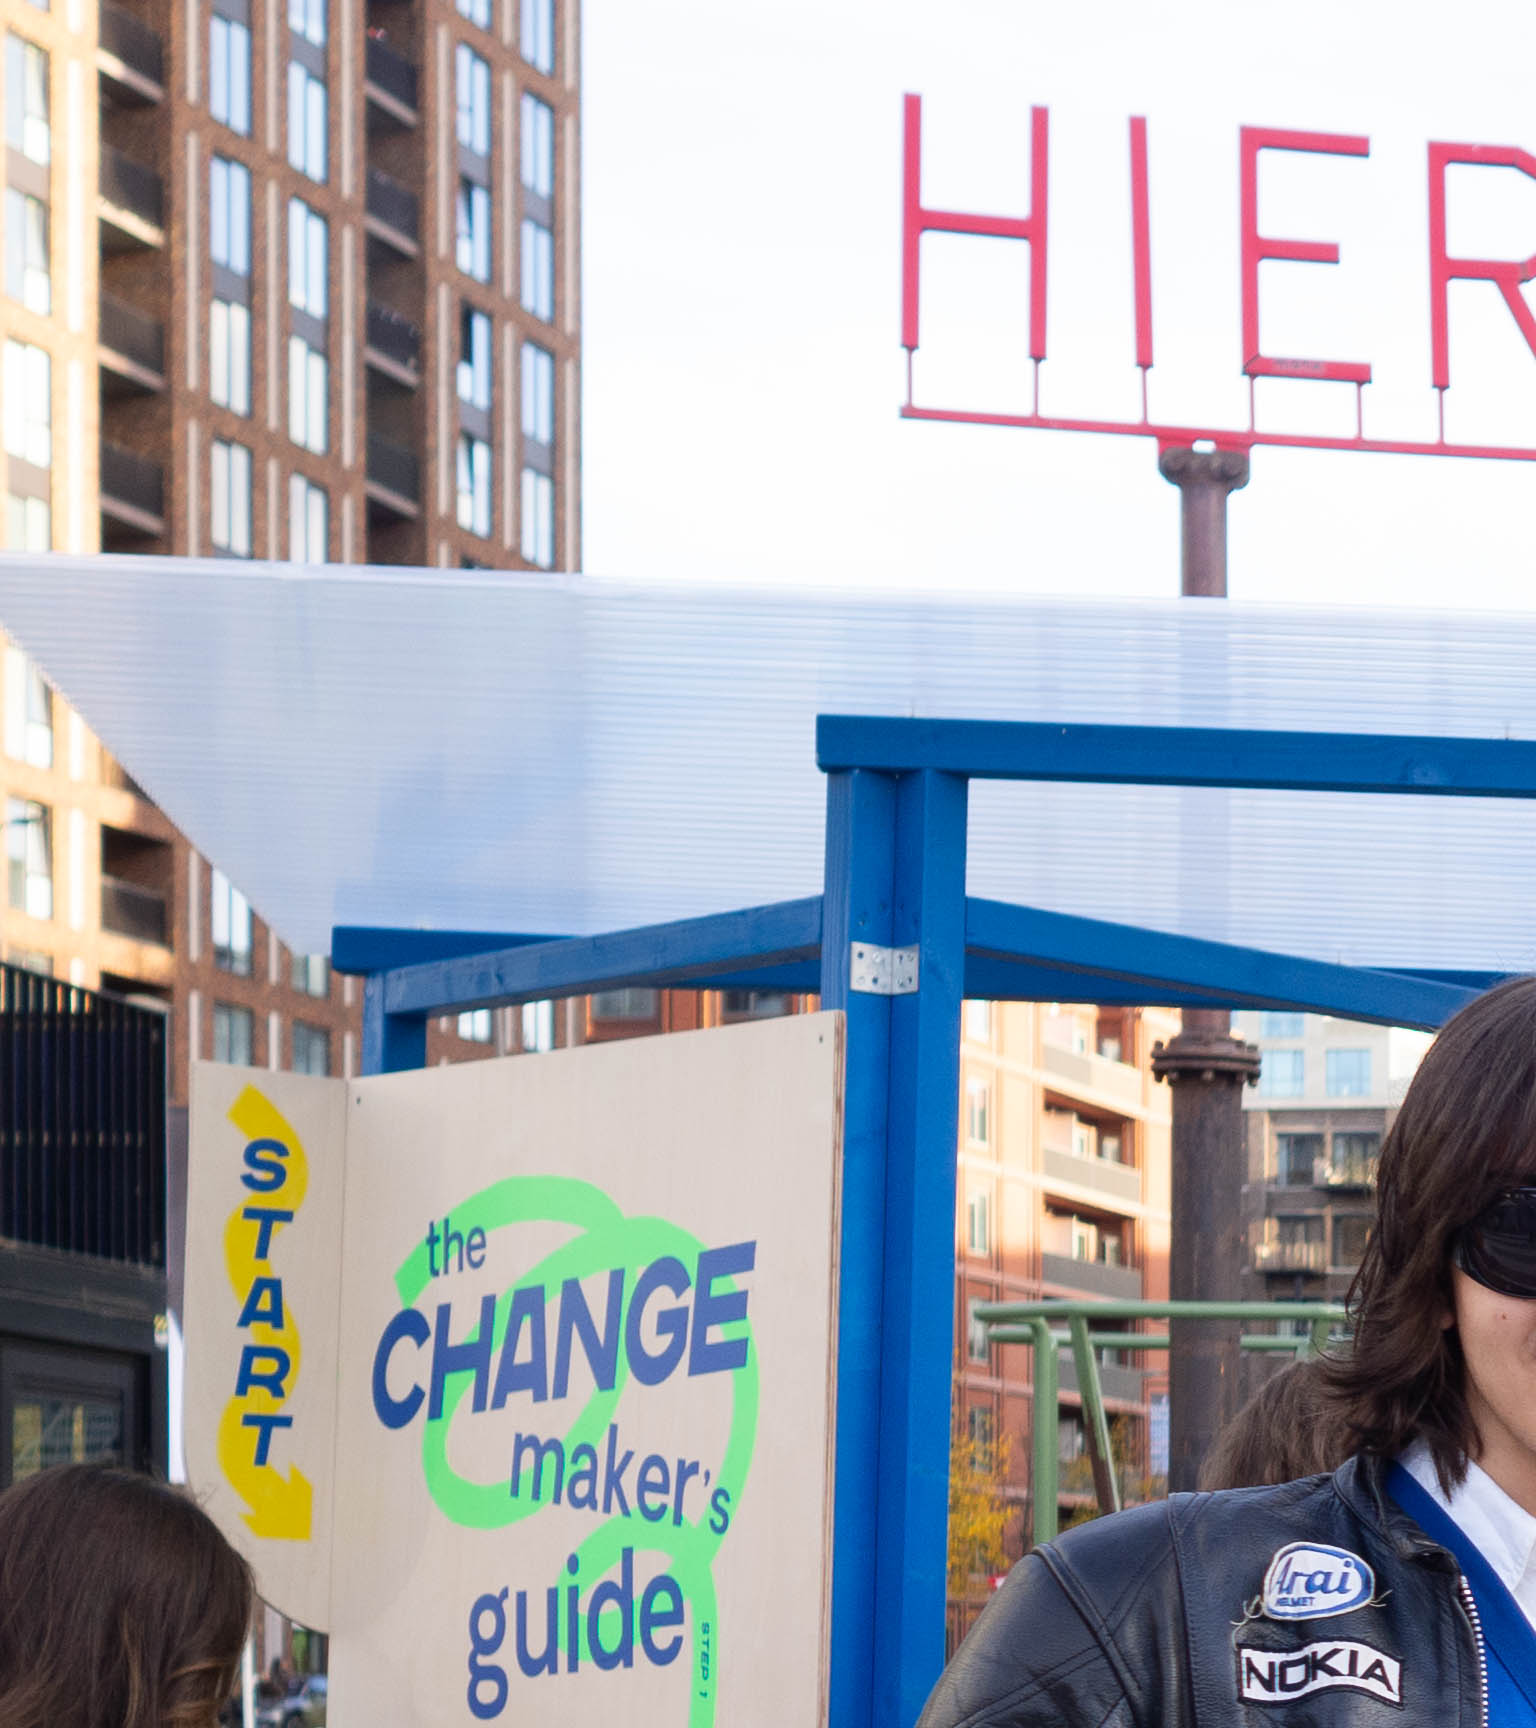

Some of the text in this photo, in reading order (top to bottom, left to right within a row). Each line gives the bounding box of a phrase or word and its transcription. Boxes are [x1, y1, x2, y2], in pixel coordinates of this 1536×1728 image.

[426, 1219, 488, 1279] the
[236, 1139, 295, 1467] START
[372, 1240, 757, 1430] CHANGE
[509, 1426, 732, 1538] maker's
[1274, 1556, 1353, 1595] Arai
[466, 1552, 686, 1720] guide
[701, 1622, 710, 1681] STEP
[1246, 1648, 1394, 1693] NOKIA
